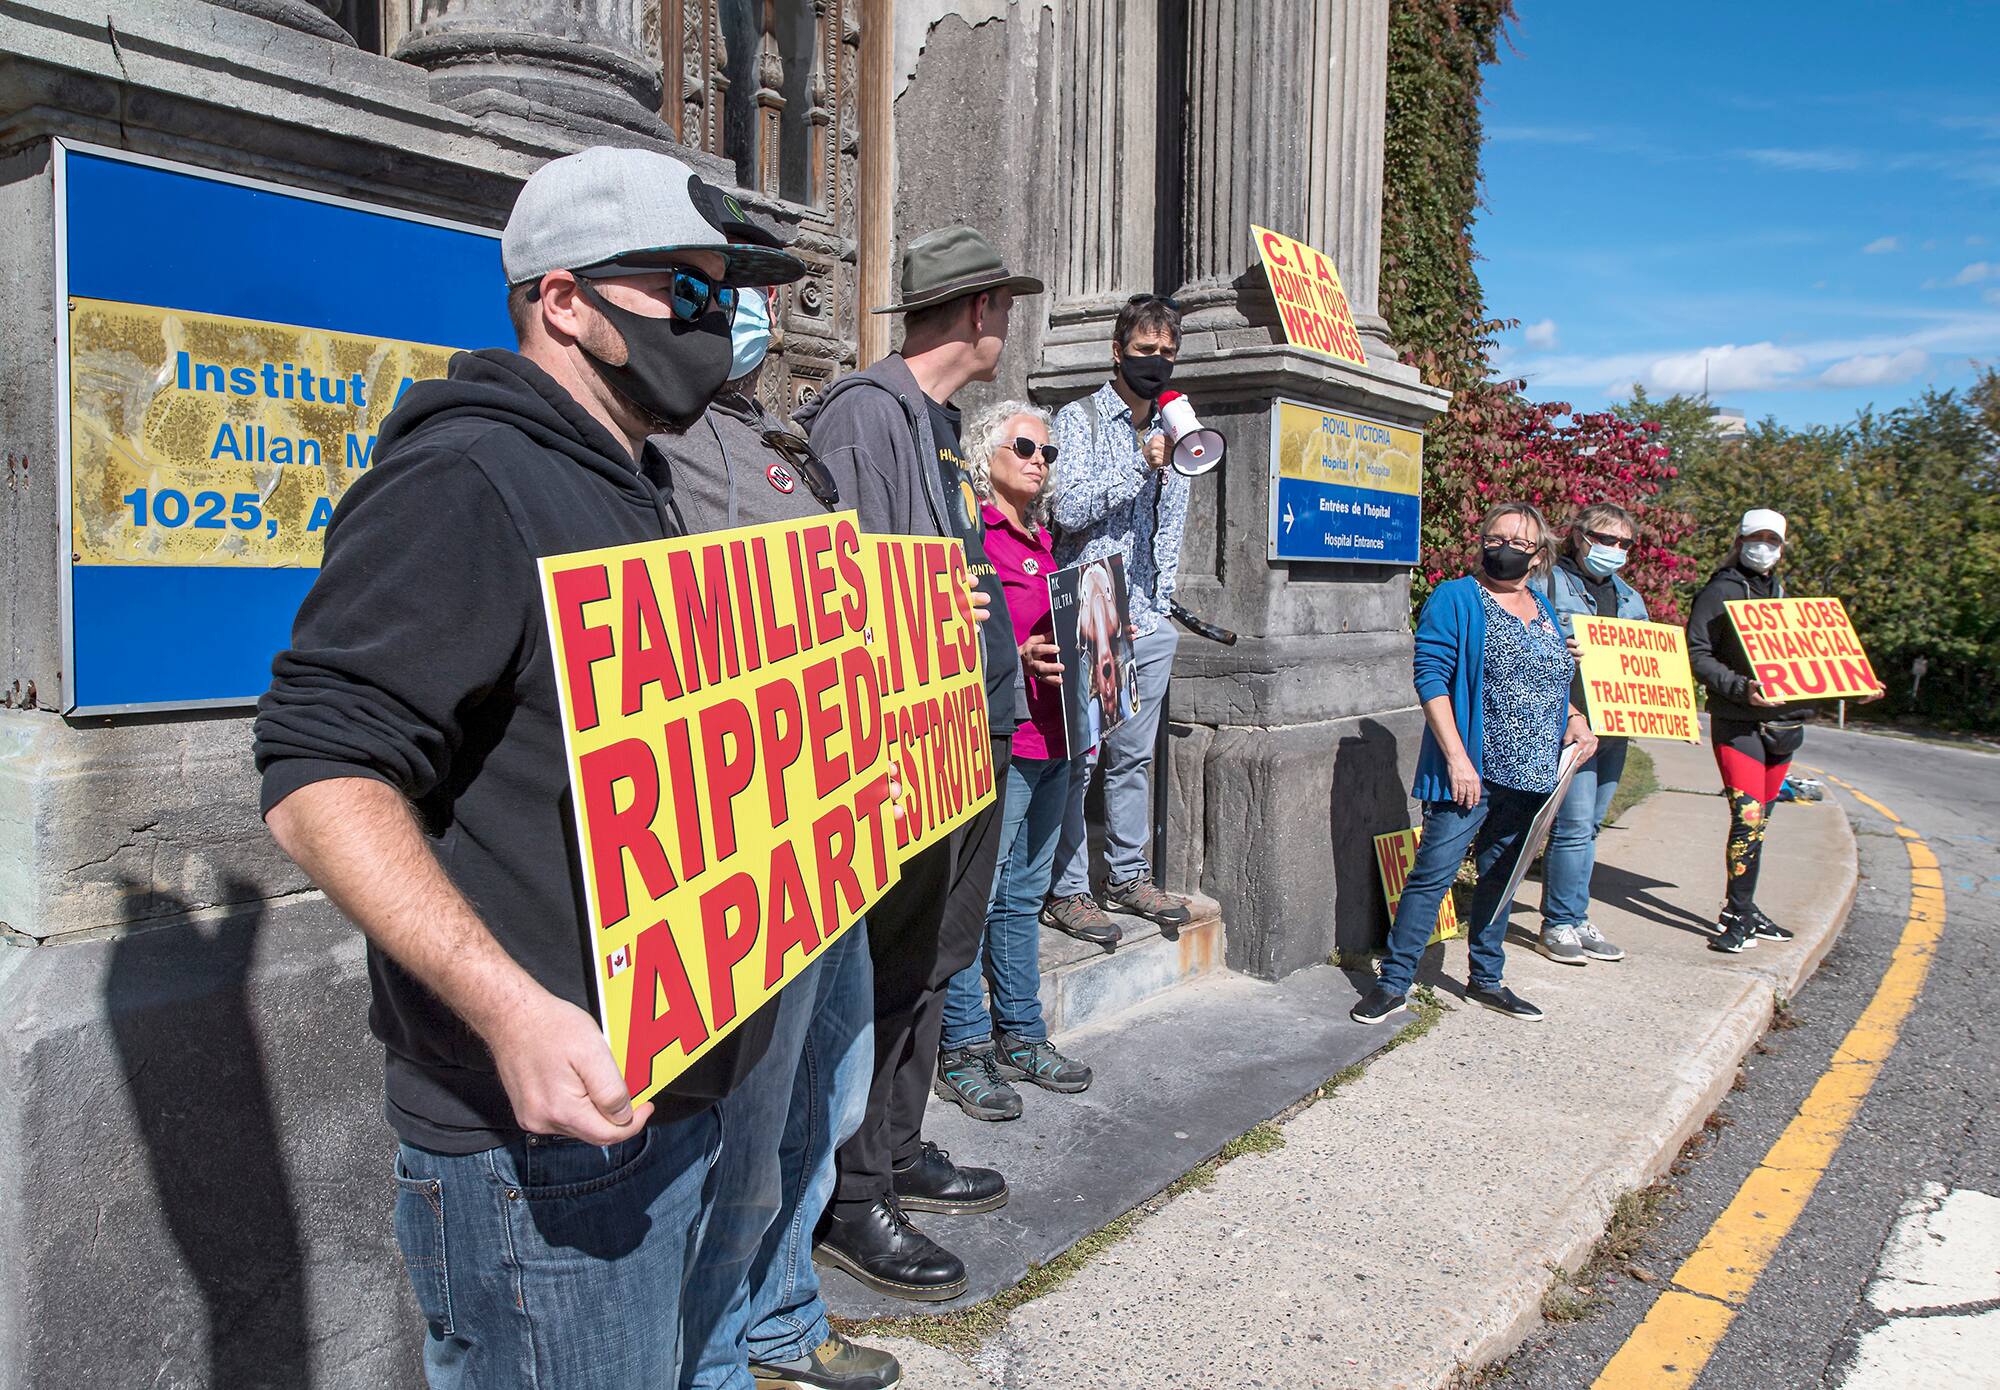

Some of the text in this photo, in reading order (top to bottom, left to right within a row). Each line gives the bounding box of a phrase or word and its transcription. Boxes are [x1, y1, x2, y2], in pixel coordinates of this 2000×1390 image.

[1270, 265, 1353, 326] ADMIT YOUR
[1279, 302, 1365, 365] WRONGS
[177, 351, 367, 407] Institut
[210, 423, 321, 466] Allan
[1322, 416, 1391, 446] ROYAL VICTORIA
[123, 488, 278, 540] 1025,
[1319, 497, 1349, 514] Entrées
[1352, 502, 1361, 515] de
[1324, 532, 1385, 550] Hospital Entrances
[877, 542, 976, 698] IVES
[1053, 592, 1073, 610] ULTRA
[1728, 601, 1848, 632] LOST JOBS
[552, 519, 869, 733] FAMILIES
[1587, 619, 1678, 654] RÉPARATION
[1742, 630, 1862, 661] FINANCIAL
[1620, 653, 1661, 679] POUR
[1754, 659, 1879, 698] RUIN
[1591, 680, 1691, 710] TRAITEMENTS
[1603, 710, 1691, 737] DE TORTURE
[884, 682, 992, 851] ESTROYED
[579, 645, 884, 930] RIPPED
[1376, 834, 1408, 897] WE
[624, 772, 890, 1101] APART
